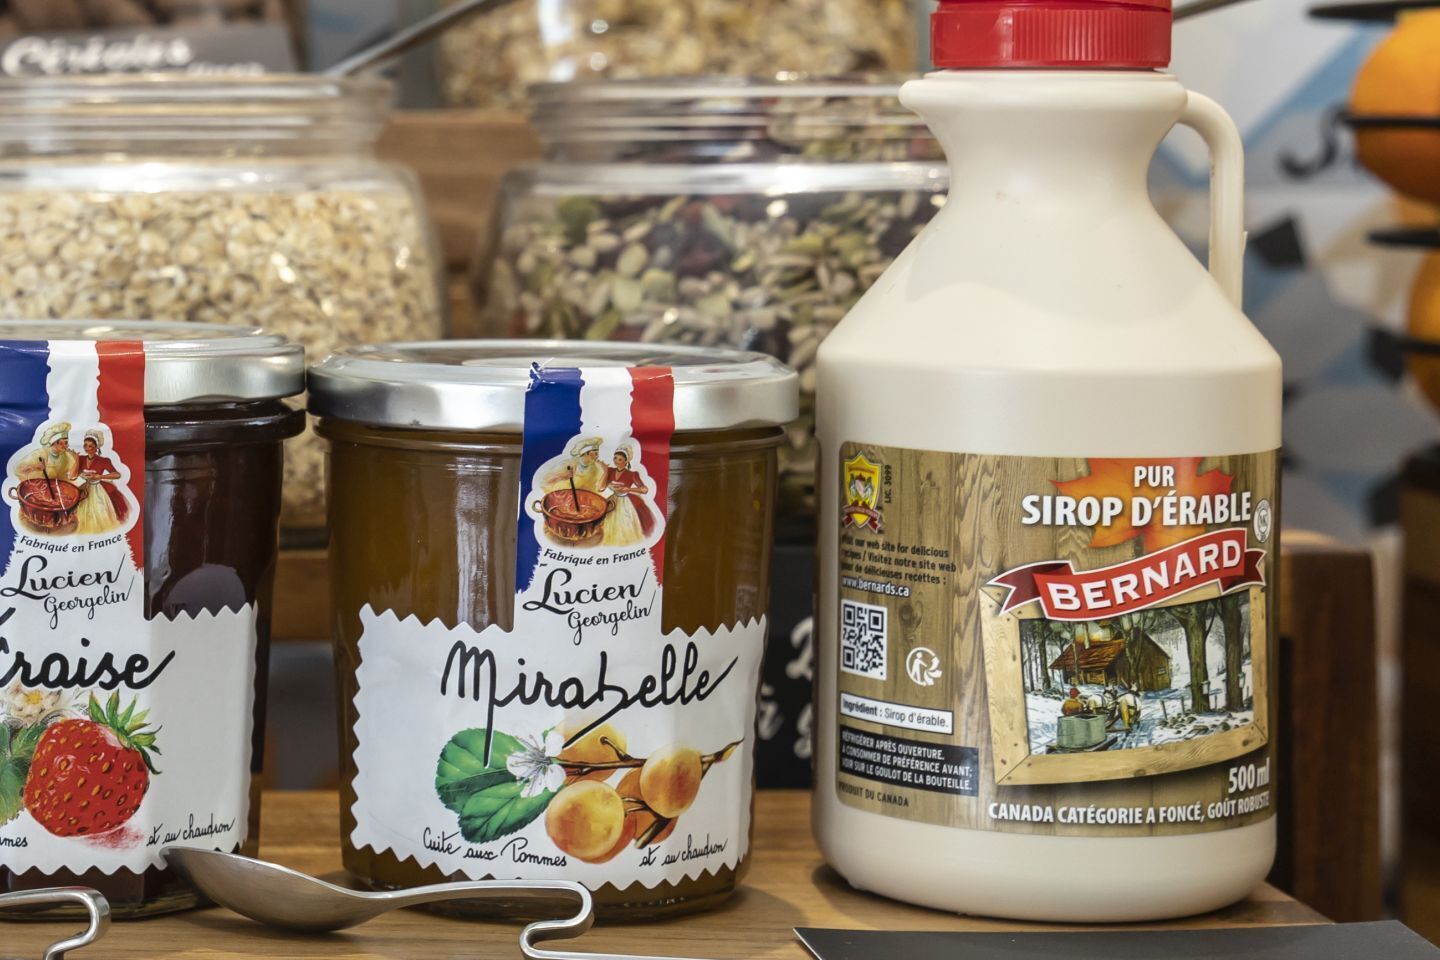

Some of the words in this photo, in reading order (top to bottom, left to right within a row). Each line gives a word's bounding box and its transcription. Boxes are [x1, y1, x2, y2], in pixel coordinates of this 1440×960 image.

[1134, 466, 1174, 487] PUR
[1021, 495, 1123, 527] SIROP
[1131, 490, 1251, 527] D'ÉRABLE
[20, 535, 69, 553] Fabriqué
[71, 544, 84, 552] en
[88, 533, 122, 550] France
[544, 548, 594, 566] Fabriqué
[596, 557, 609, 565] en
[613, 548, 646, 563] France
[882, 541, 895, 552] site
[897, 543, 908, 553] for
[911, 545, 949, 558] delicious
[0, 553, 126, 600] Lucien
[864, 565, 902, 580] délicieuses
[905, 573, 940, 585] recettes
[867, 551, 892, 565] Visitez
[895, 556, 916, 568] notre
[919, 558, 936, 570] site
[939, 562, 957, 573] web
[1047, 539, 1241, 611] BERNARD
[522, 567, 650, 615] Lucien
[842, 576, 910, 598] www.bernards.ca
[44, 575, 135, 630] Georgelin
[567, 589, 656, 646] Georgelin
[441, 640, 738, 767] Mirabelle
[843, 698, 877, 715] Ingrédient
[884, 708, 906, 723] Sirop
[908, 711, 949, 728] d'érable.
[846, 747, 880, 762] CONSOMMER
[882, 754, 891, 764] DE
[893, 755, 940, 773] PRÉFÉRENCE
[875, 739, 896, 753] APRÈS
[898, 744, 945, 760] OUVERTURE.
[854, 761, 865, 772] SUR
[866, 763, 874, 775] LE
[875, 766, 901, 780] GOULOT
[903, 770, 912, 782] DE
[914, 773, 924, 784] LA
[926, 775, 973, 790] BOUTEILLE.
[1228, 763, 1255, 793] 500
[1256, 757, 1270, 787] ml
[839, 781, 863, 797] PRODUIT
[865, 788, 875, 800] DU
[877, 791, 909, 807] CANADA
[988, 803, 1054, 823] CANADA
[1058, 804, 1142, 824] CATÉGORIE
[1146, 807, 1156, 824] A
[1160, 801, 1205, 822] FONCÉ,
[1207, 798, 1236, 819] GOÛT
[146, 823, 163, 847] et
[162, 829, 181, 845] au
[183, 812, 236, 840] chaudron
[423, 827, 461, 854] Cuite
[463, 847, 498, 860] aux
[500, 837, 567, 866] Pommes
[639, 845, 661, 867] et
[661, 850, 680, 866] au
[681, 833, 728, 861] chaudron
